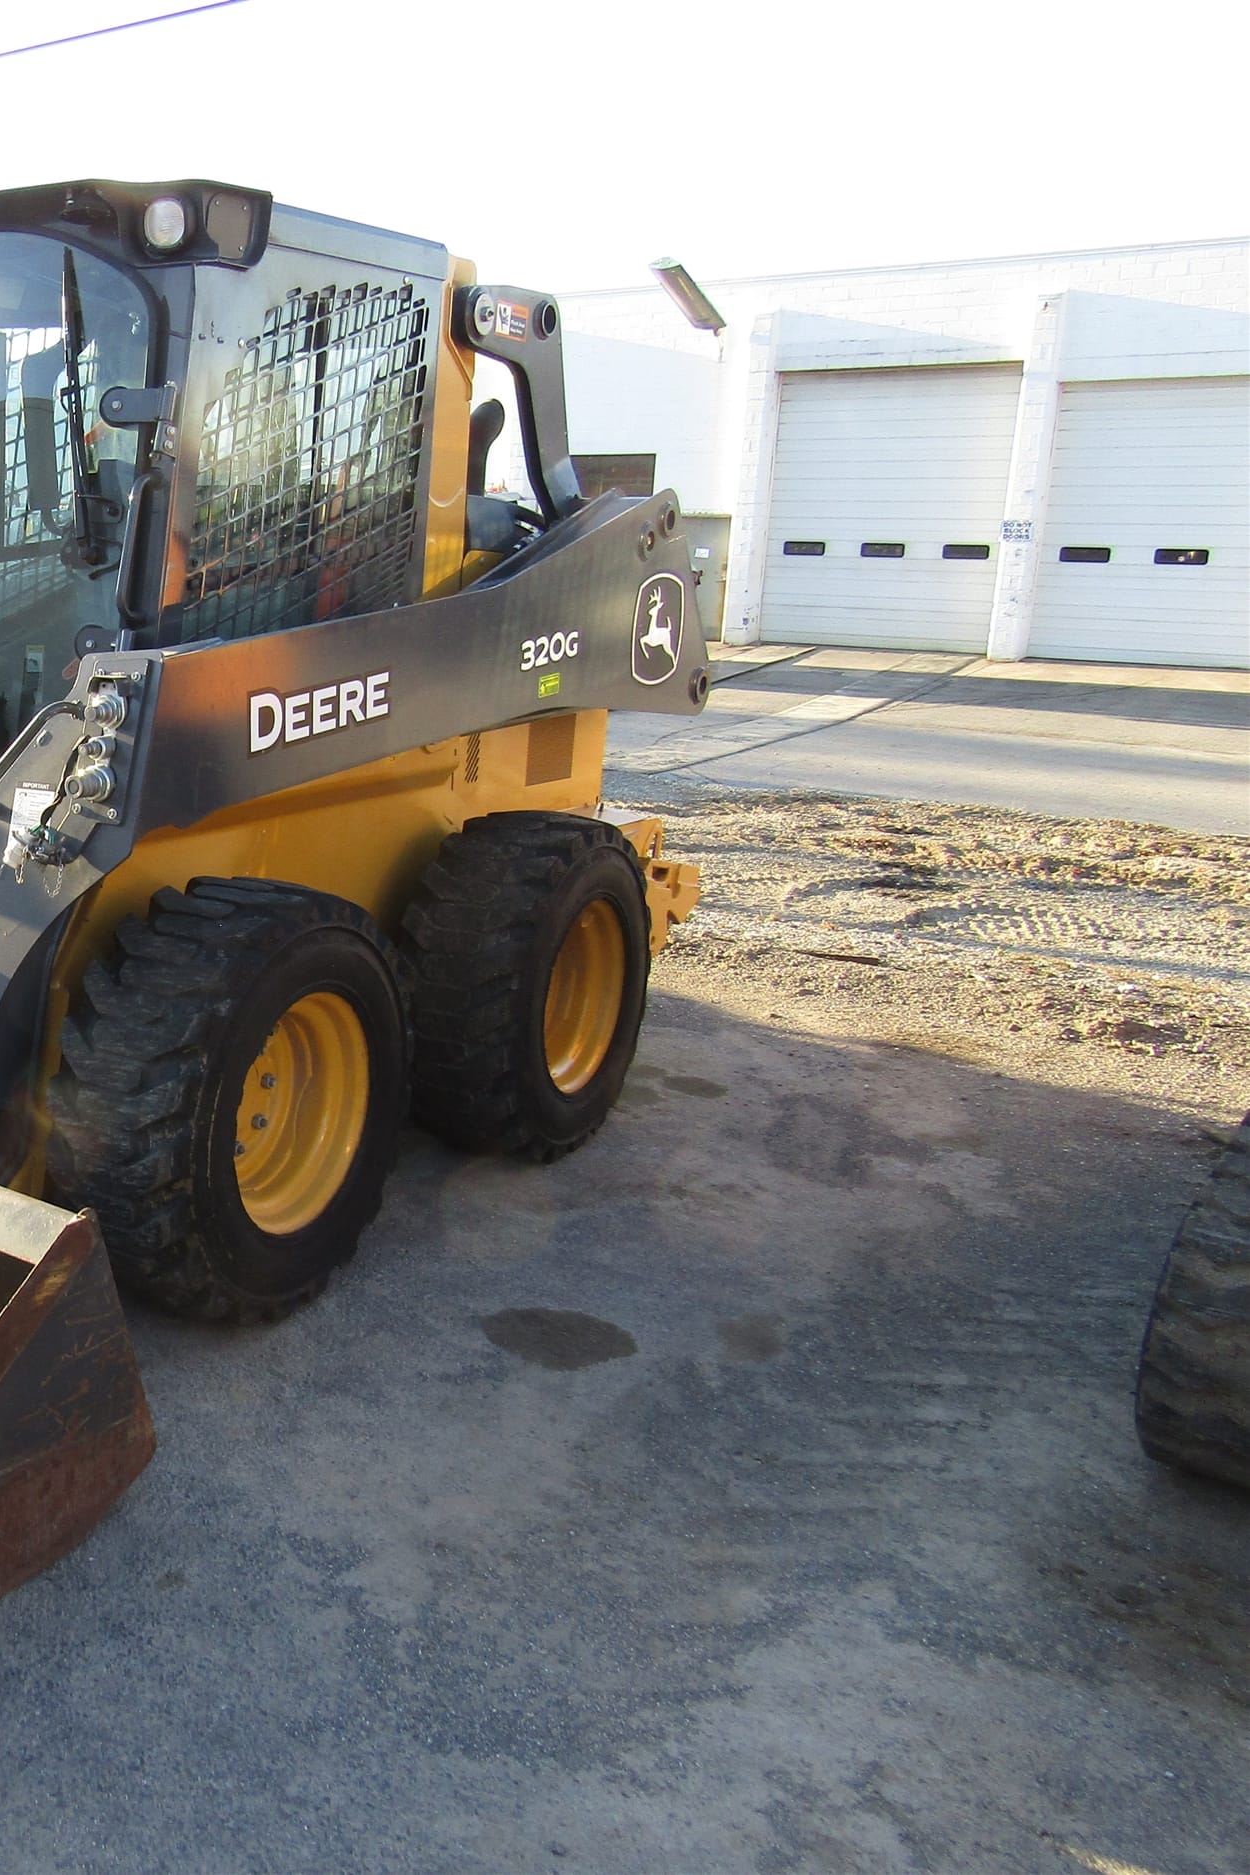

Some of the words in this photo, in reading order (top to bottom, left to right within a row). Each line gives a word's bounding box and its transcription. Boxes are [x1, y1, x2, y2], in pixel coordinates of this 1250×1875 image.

[520, 631, 579, 671] 320G
[250, 671, 390, 753] DEERE
[22, 782, 50, 790] IMPORTANT
